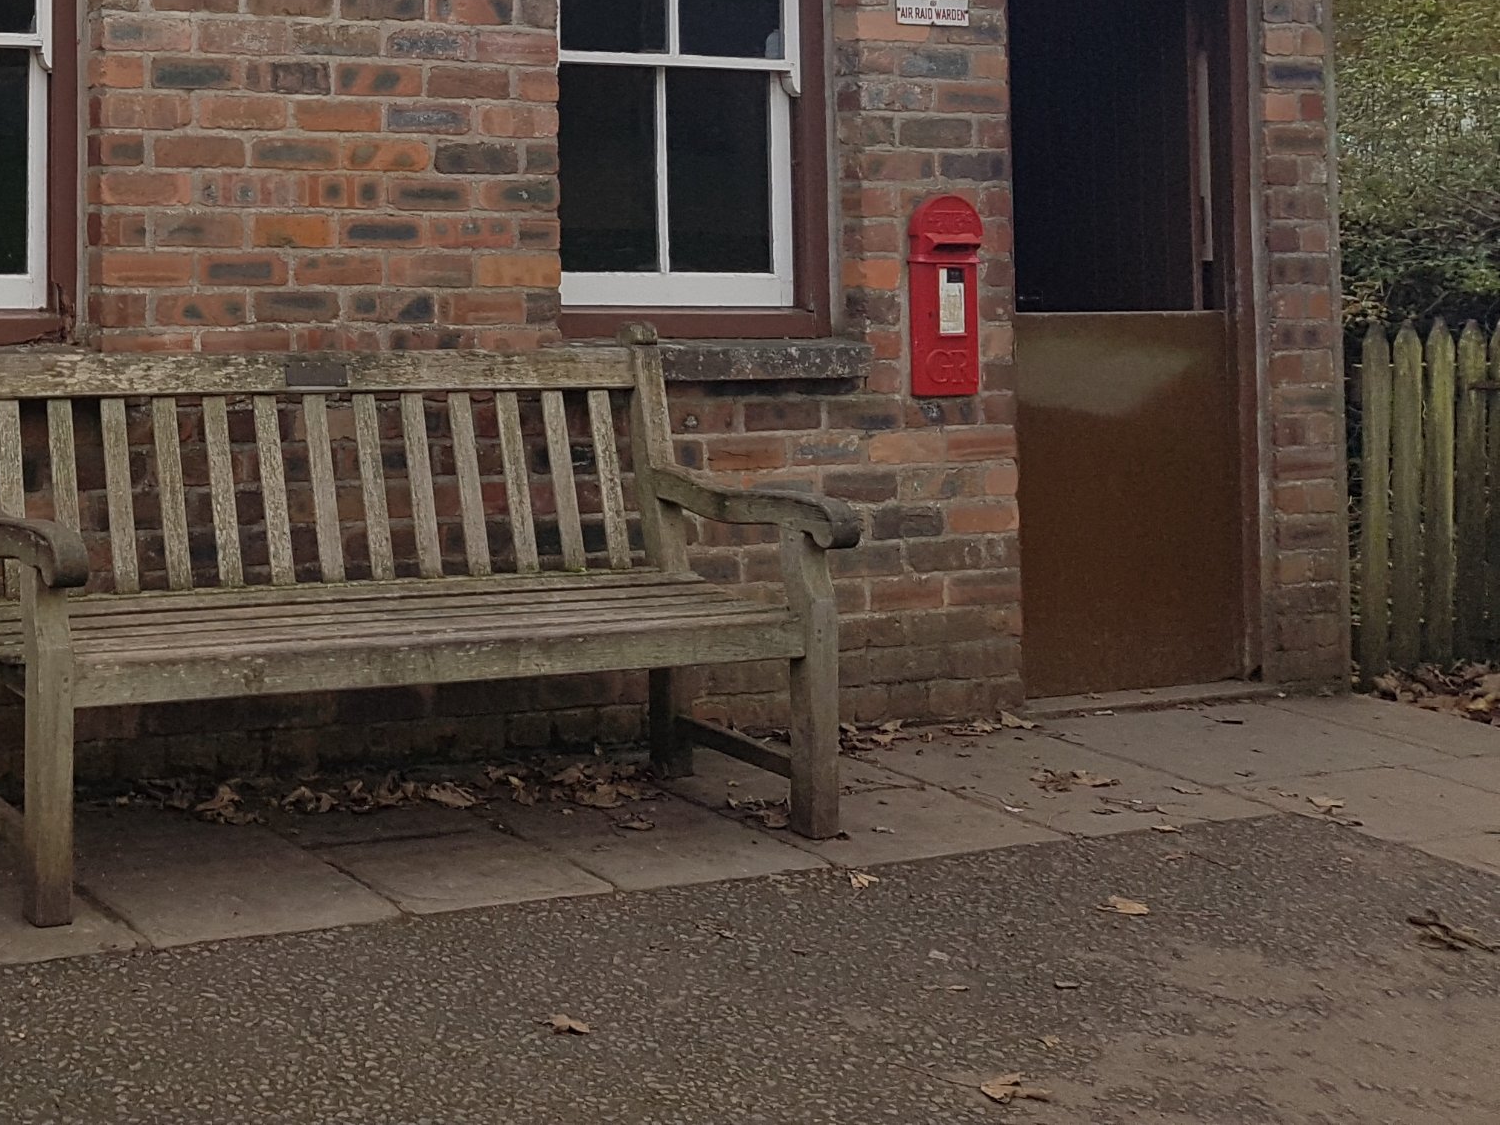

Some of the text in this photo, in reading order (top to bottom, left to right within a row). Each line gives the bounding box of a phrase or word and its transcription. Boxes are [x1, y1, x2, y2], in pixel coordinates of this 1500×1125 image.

[900, 7, 966, 21] AIR RAID WARDEN
